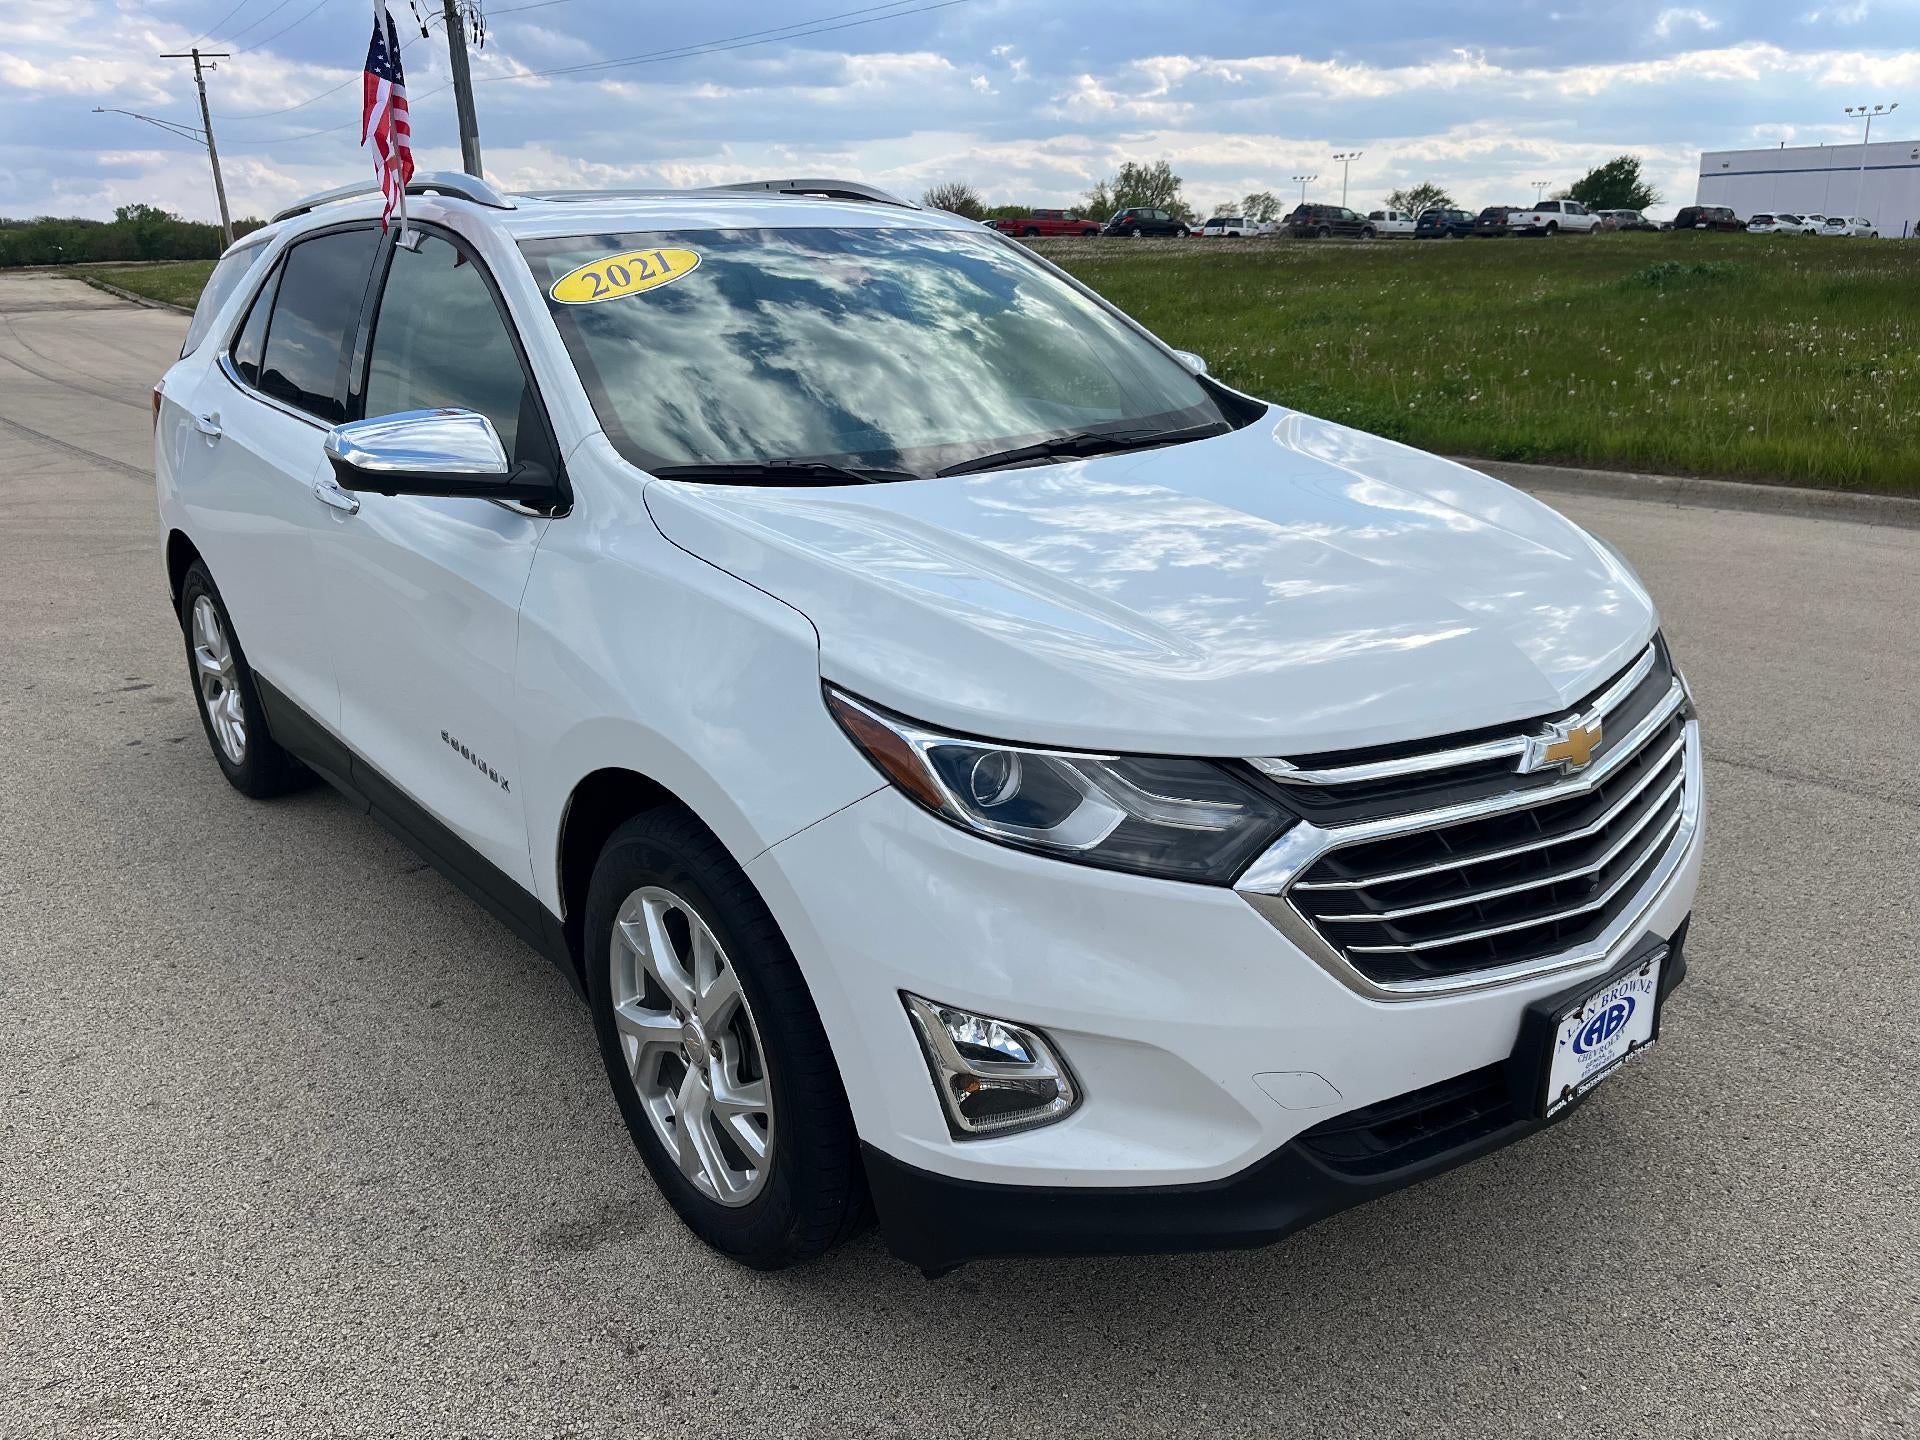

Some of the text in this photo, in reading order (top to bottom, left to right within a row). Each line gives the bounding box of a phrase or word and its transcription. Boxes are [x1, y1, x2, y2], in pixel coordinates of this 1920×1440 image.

[581, 251, 677, 298] 2021
[1601, 979, 1653, 1008] BROWNE
[1583, 1003, 1626, 1047] AB
[1577, 1028, 1625, 1063] CHEVROLET
